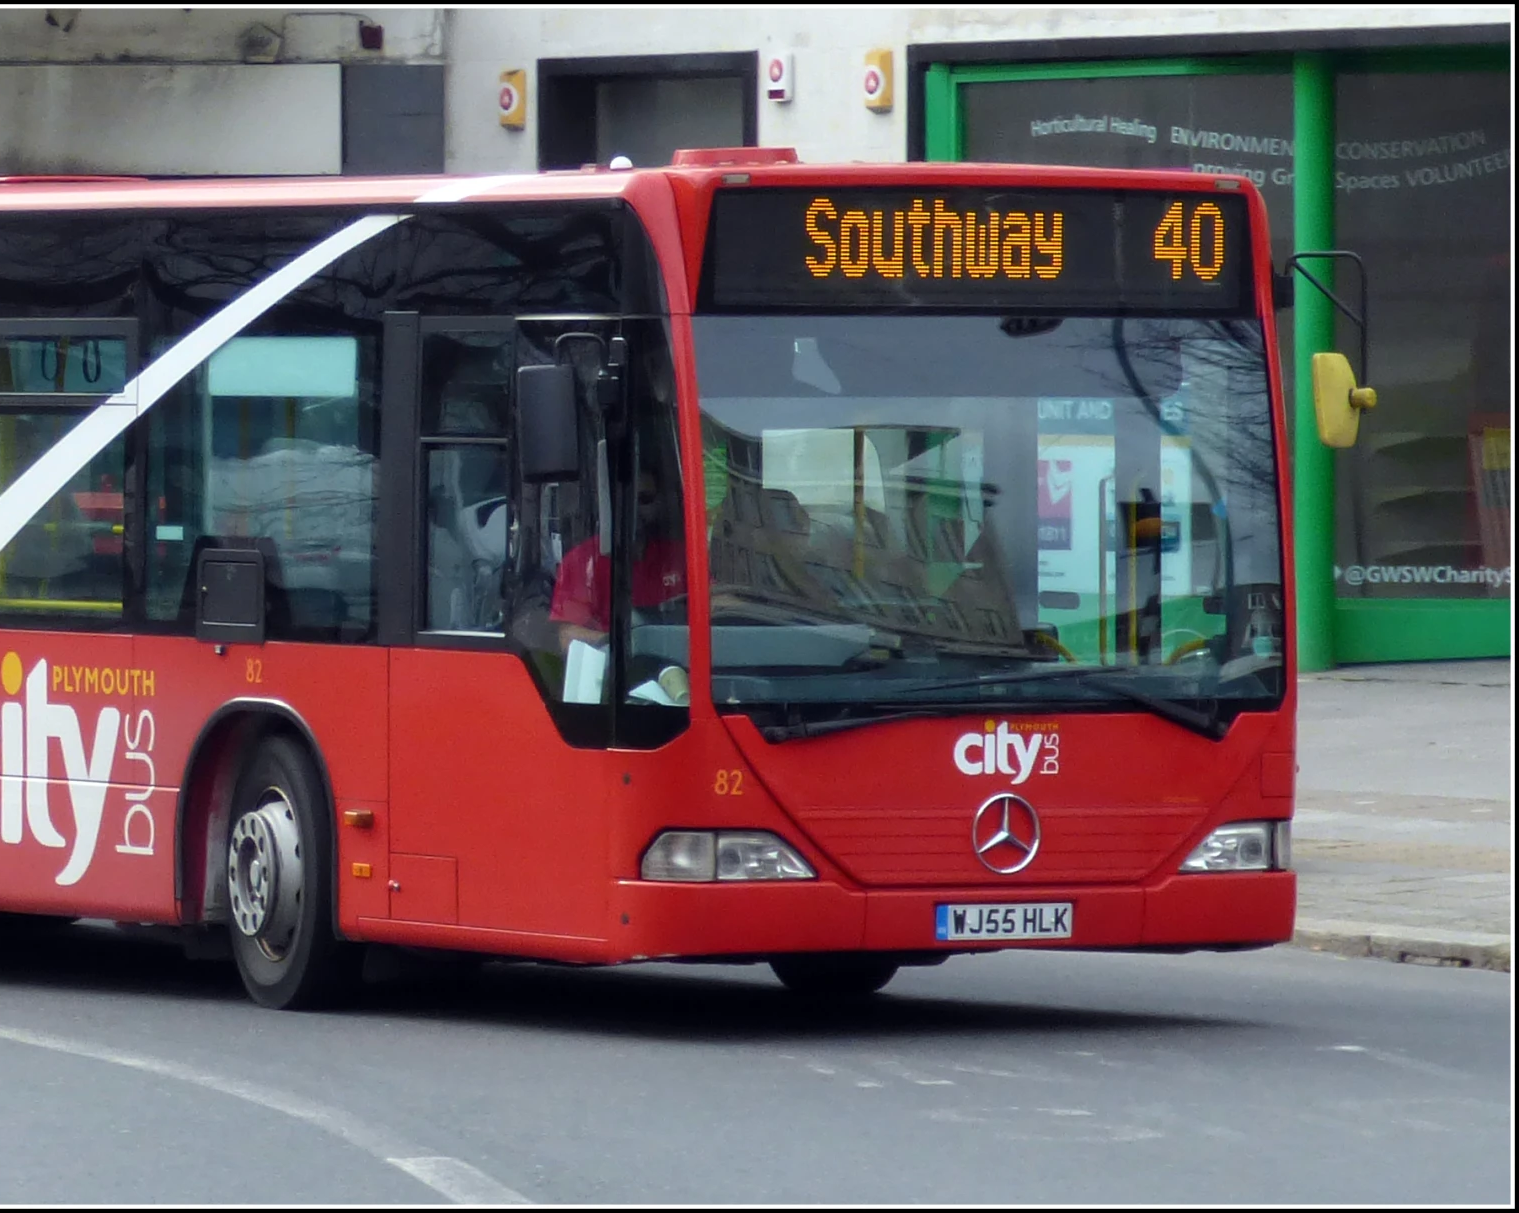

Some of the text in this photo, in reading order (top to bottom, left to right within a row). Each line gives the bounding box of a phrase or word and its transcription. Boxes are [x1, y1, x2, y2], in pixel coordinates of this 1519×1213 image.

[1030, 113, 1158, 144] Horticultural Healing
[1335, 128, 1487, 161] CONSERVATION
[1335, 171, 1401, 194] Spaces
[804, 197, 1225, 281] Southway 40
[52, 665, 156, 697] PLYMOUTH
[246, 658, 262, 684] 82
[1010, 722, 1060, 732] PLYMOUTH
[953, 719, 1060, 785] city bus
[115, 708, 156, 856] bus
[714, 769, 744, 796] 82
[953, 907, 1068, 935] WJ55 HLK
